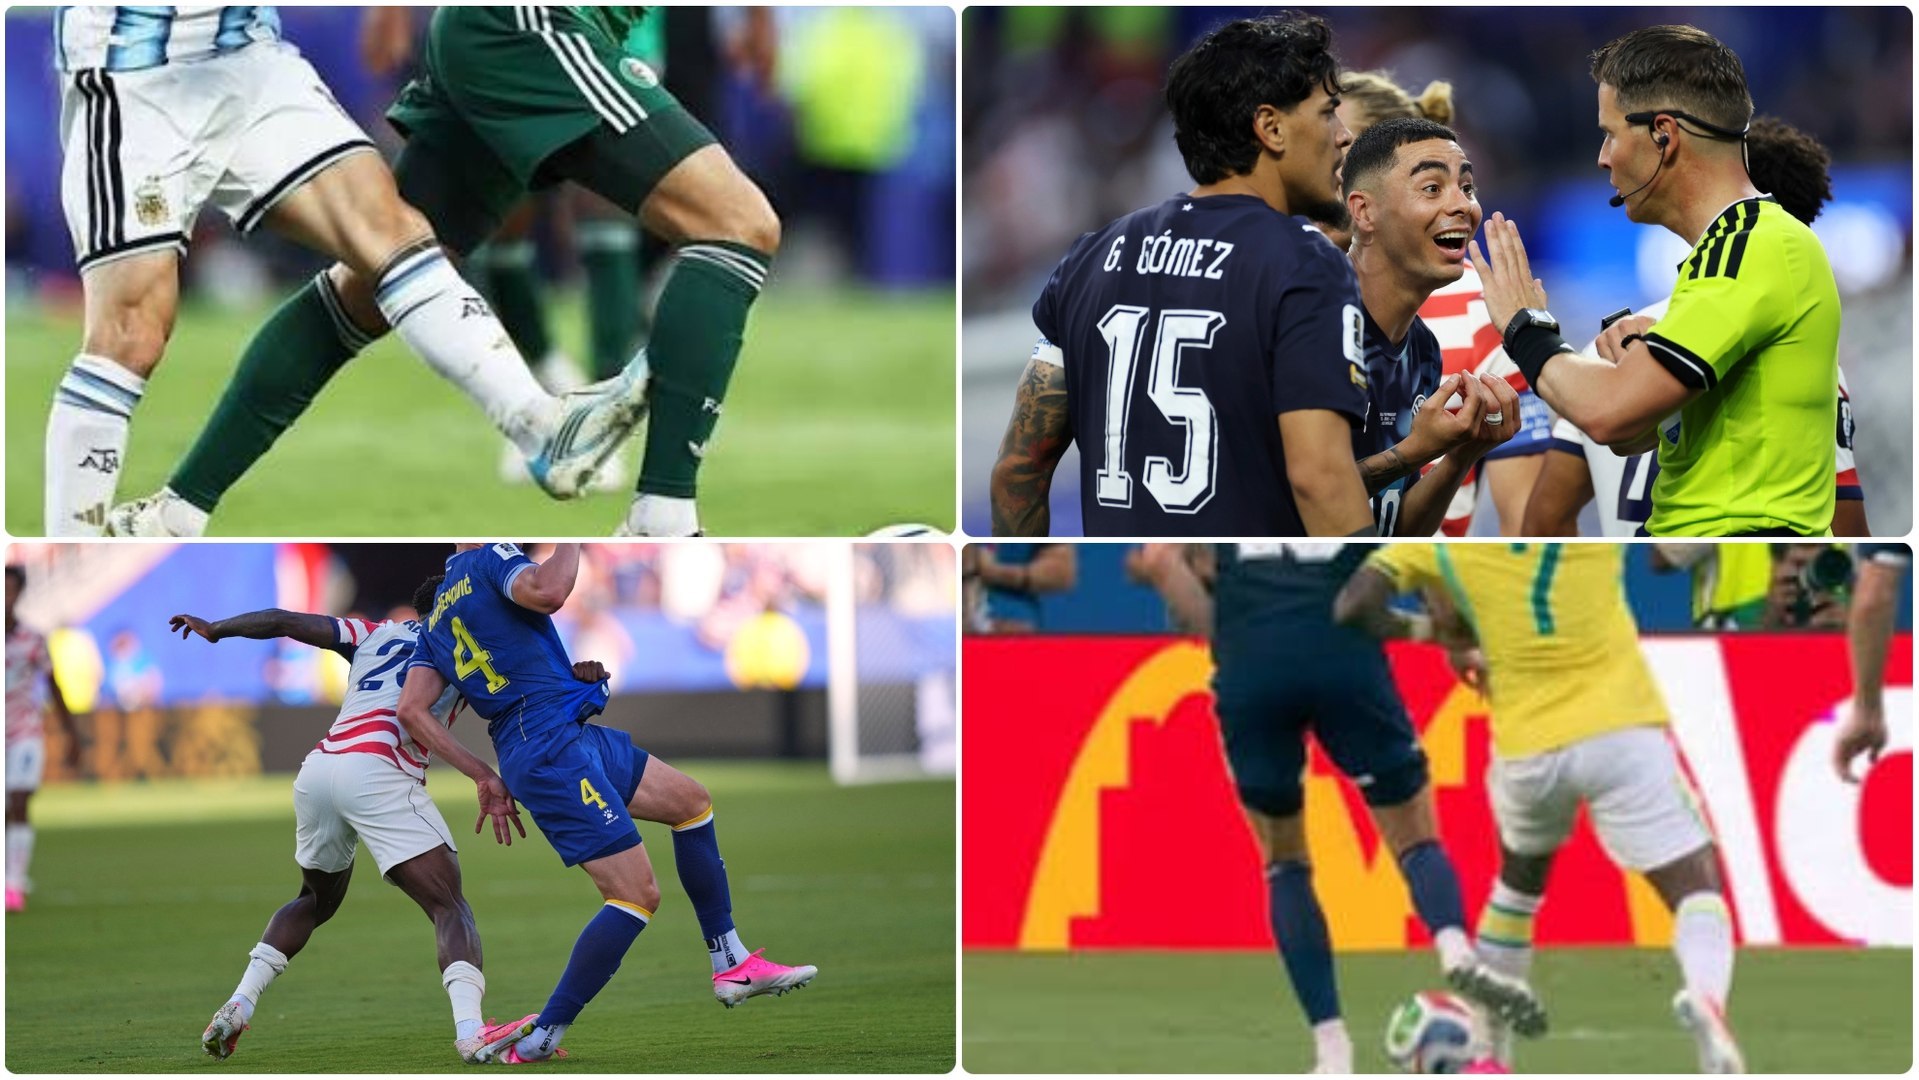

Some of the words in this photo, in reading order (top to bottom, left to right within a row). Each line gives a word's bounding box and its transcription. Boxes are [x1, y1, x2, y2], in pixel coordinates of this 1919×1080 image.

[1103, 235, 1126, 272] G.
[1136, 229, 1235, 280] GÓMEZ
[1097, 304, 1227, 515] 15
[1368, 489, 1401, 537] 0
[358, 638, 419, 691] 2
[451, 616, 511, 695] 4
[580, 778, 608, 810] 4
